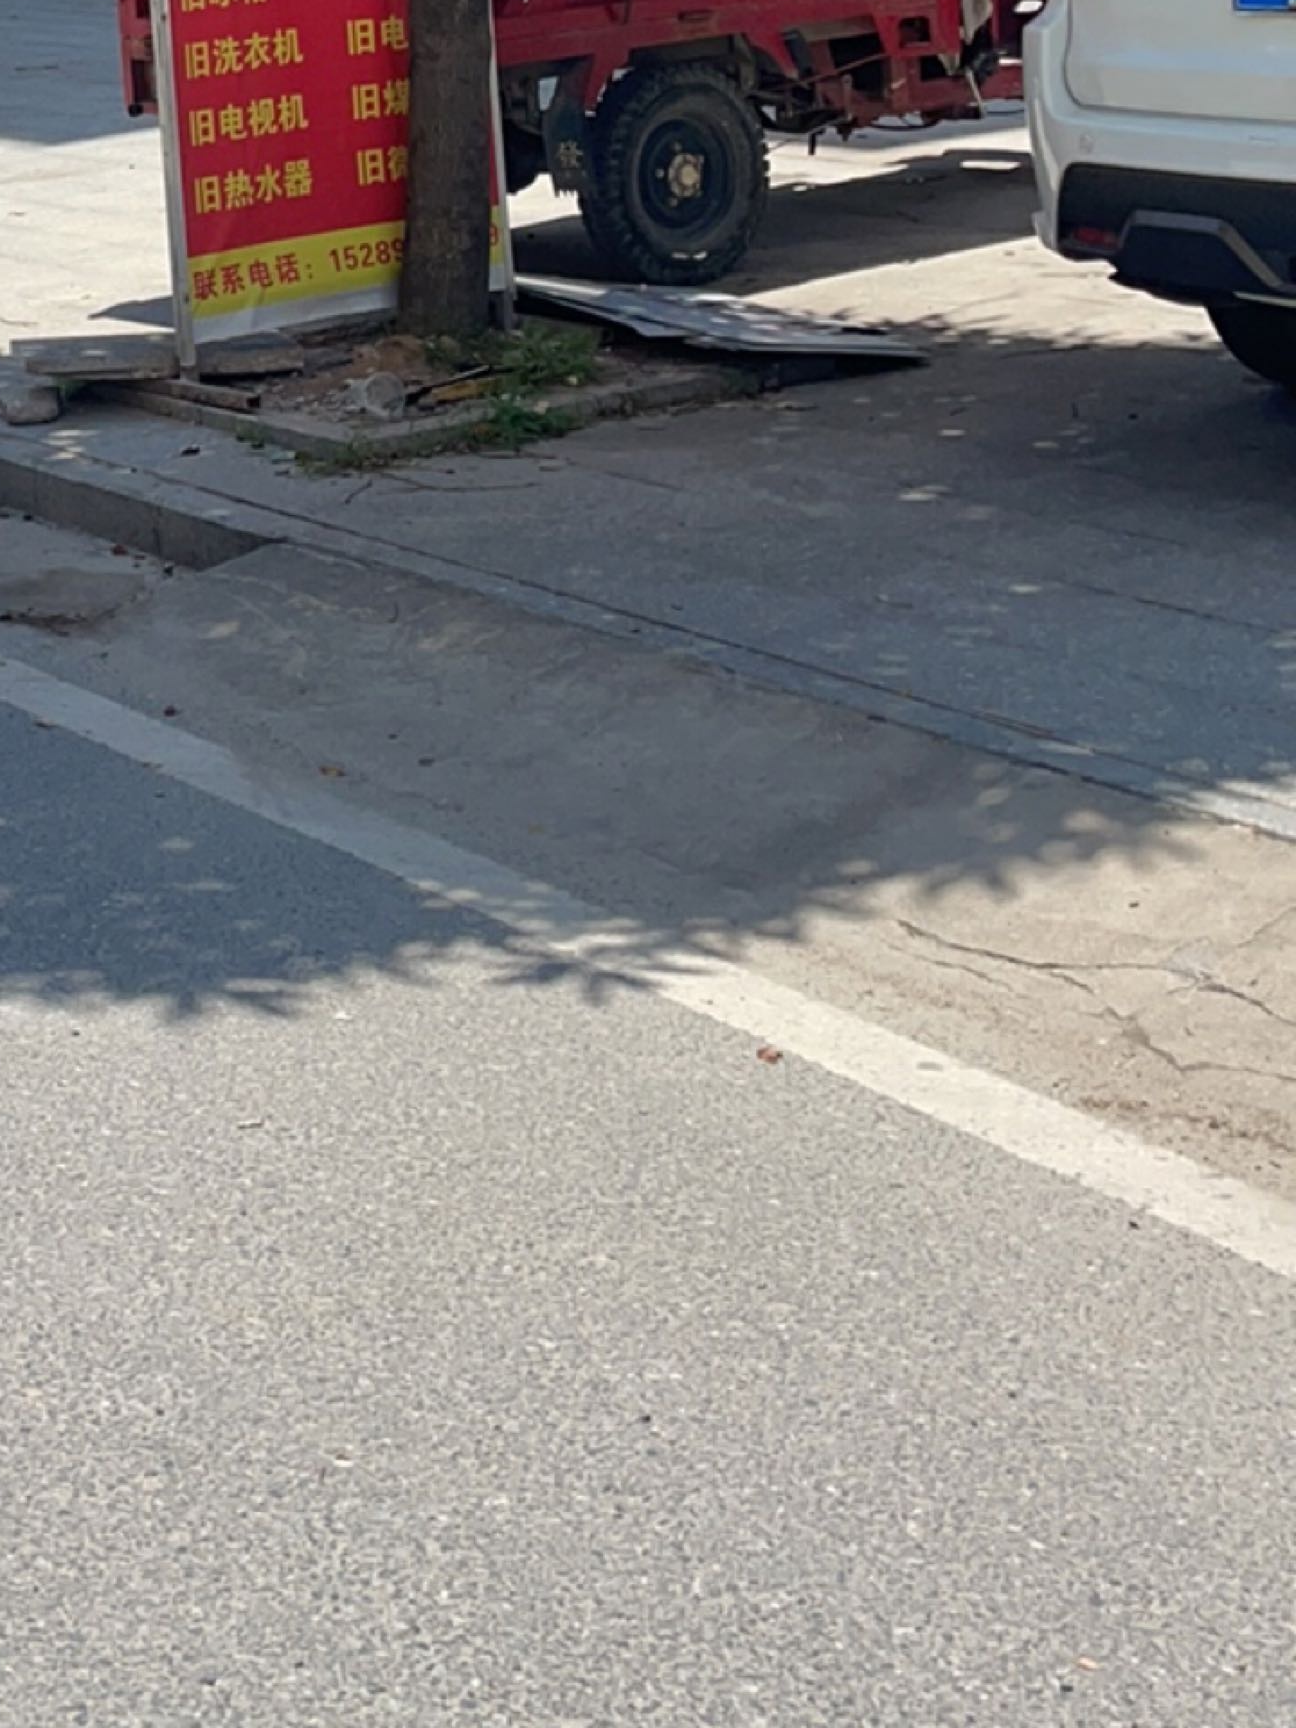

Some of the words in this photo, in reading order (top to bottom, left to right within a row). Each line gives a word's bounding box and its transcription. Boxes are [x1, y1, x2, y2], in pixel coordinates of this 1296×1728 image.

[185, 27, 304, 79] 旧洗衣机
[346, 15, 409, 56] 旧电
[188, 93, 310, 147] 旧电视机
[194, 158, 313, 215] 旧热水器
